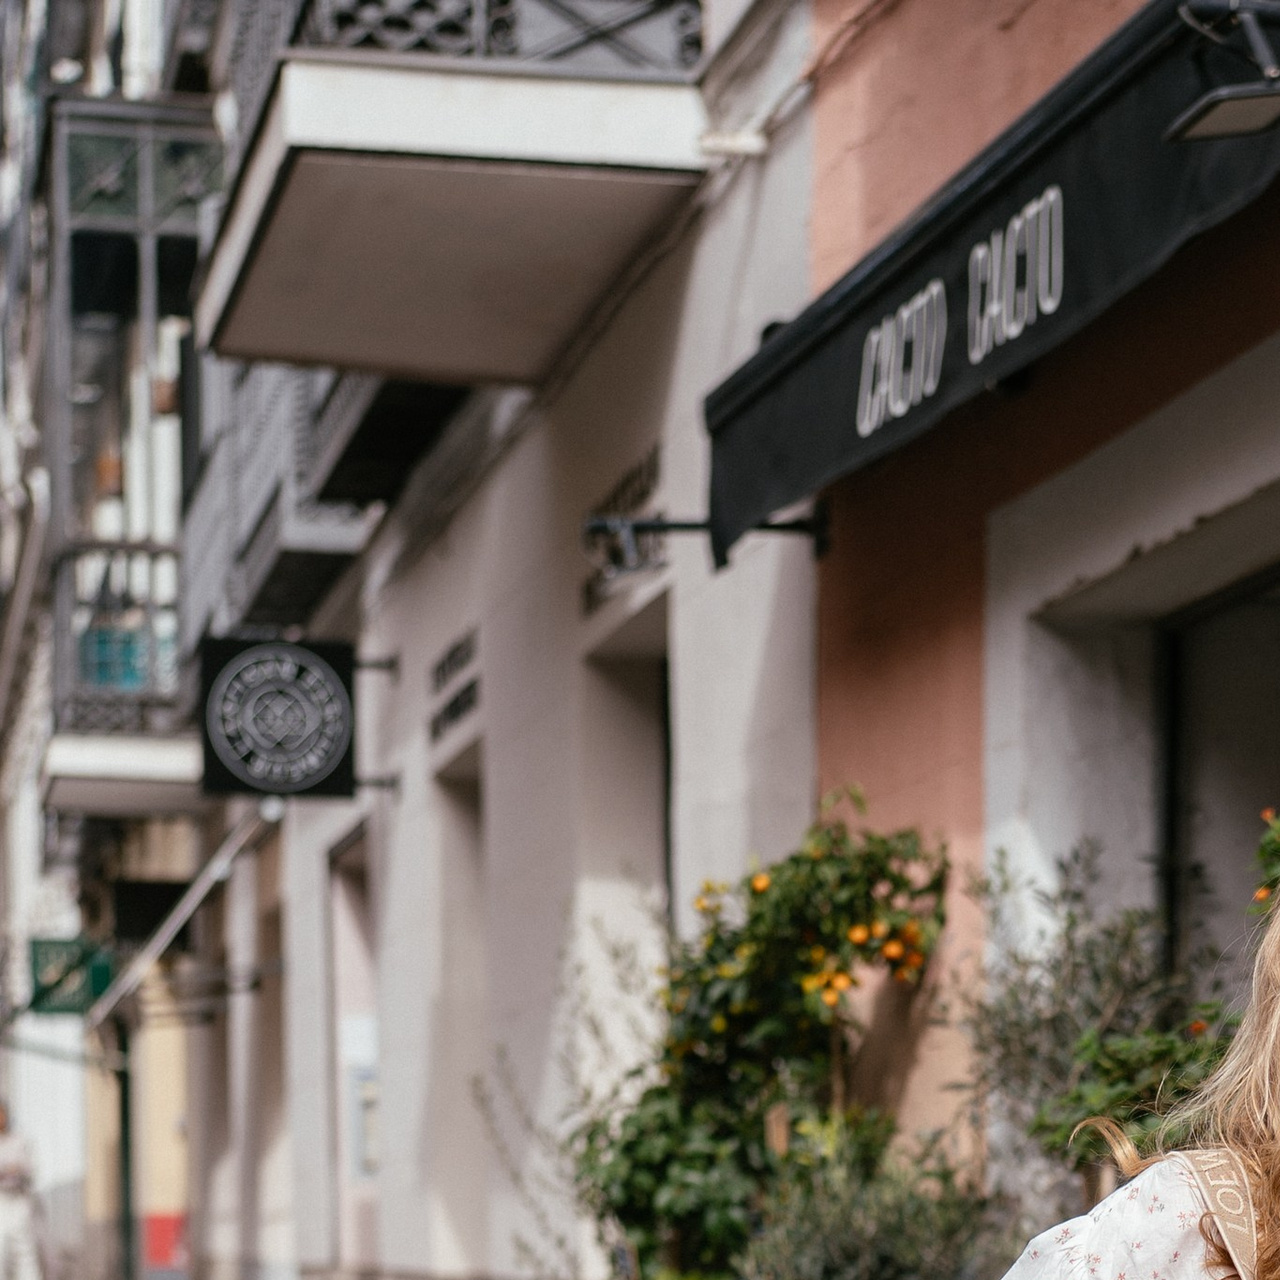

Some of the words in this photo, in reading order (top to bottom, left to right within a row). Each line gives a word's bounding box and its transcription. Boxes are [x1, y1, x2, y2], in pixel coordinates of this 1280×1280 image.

[856, 278, 948, 438] CACTO
[967, 184, 1064, 366] CACTO
[1194, 1151, 1250, 1235] LOEW
